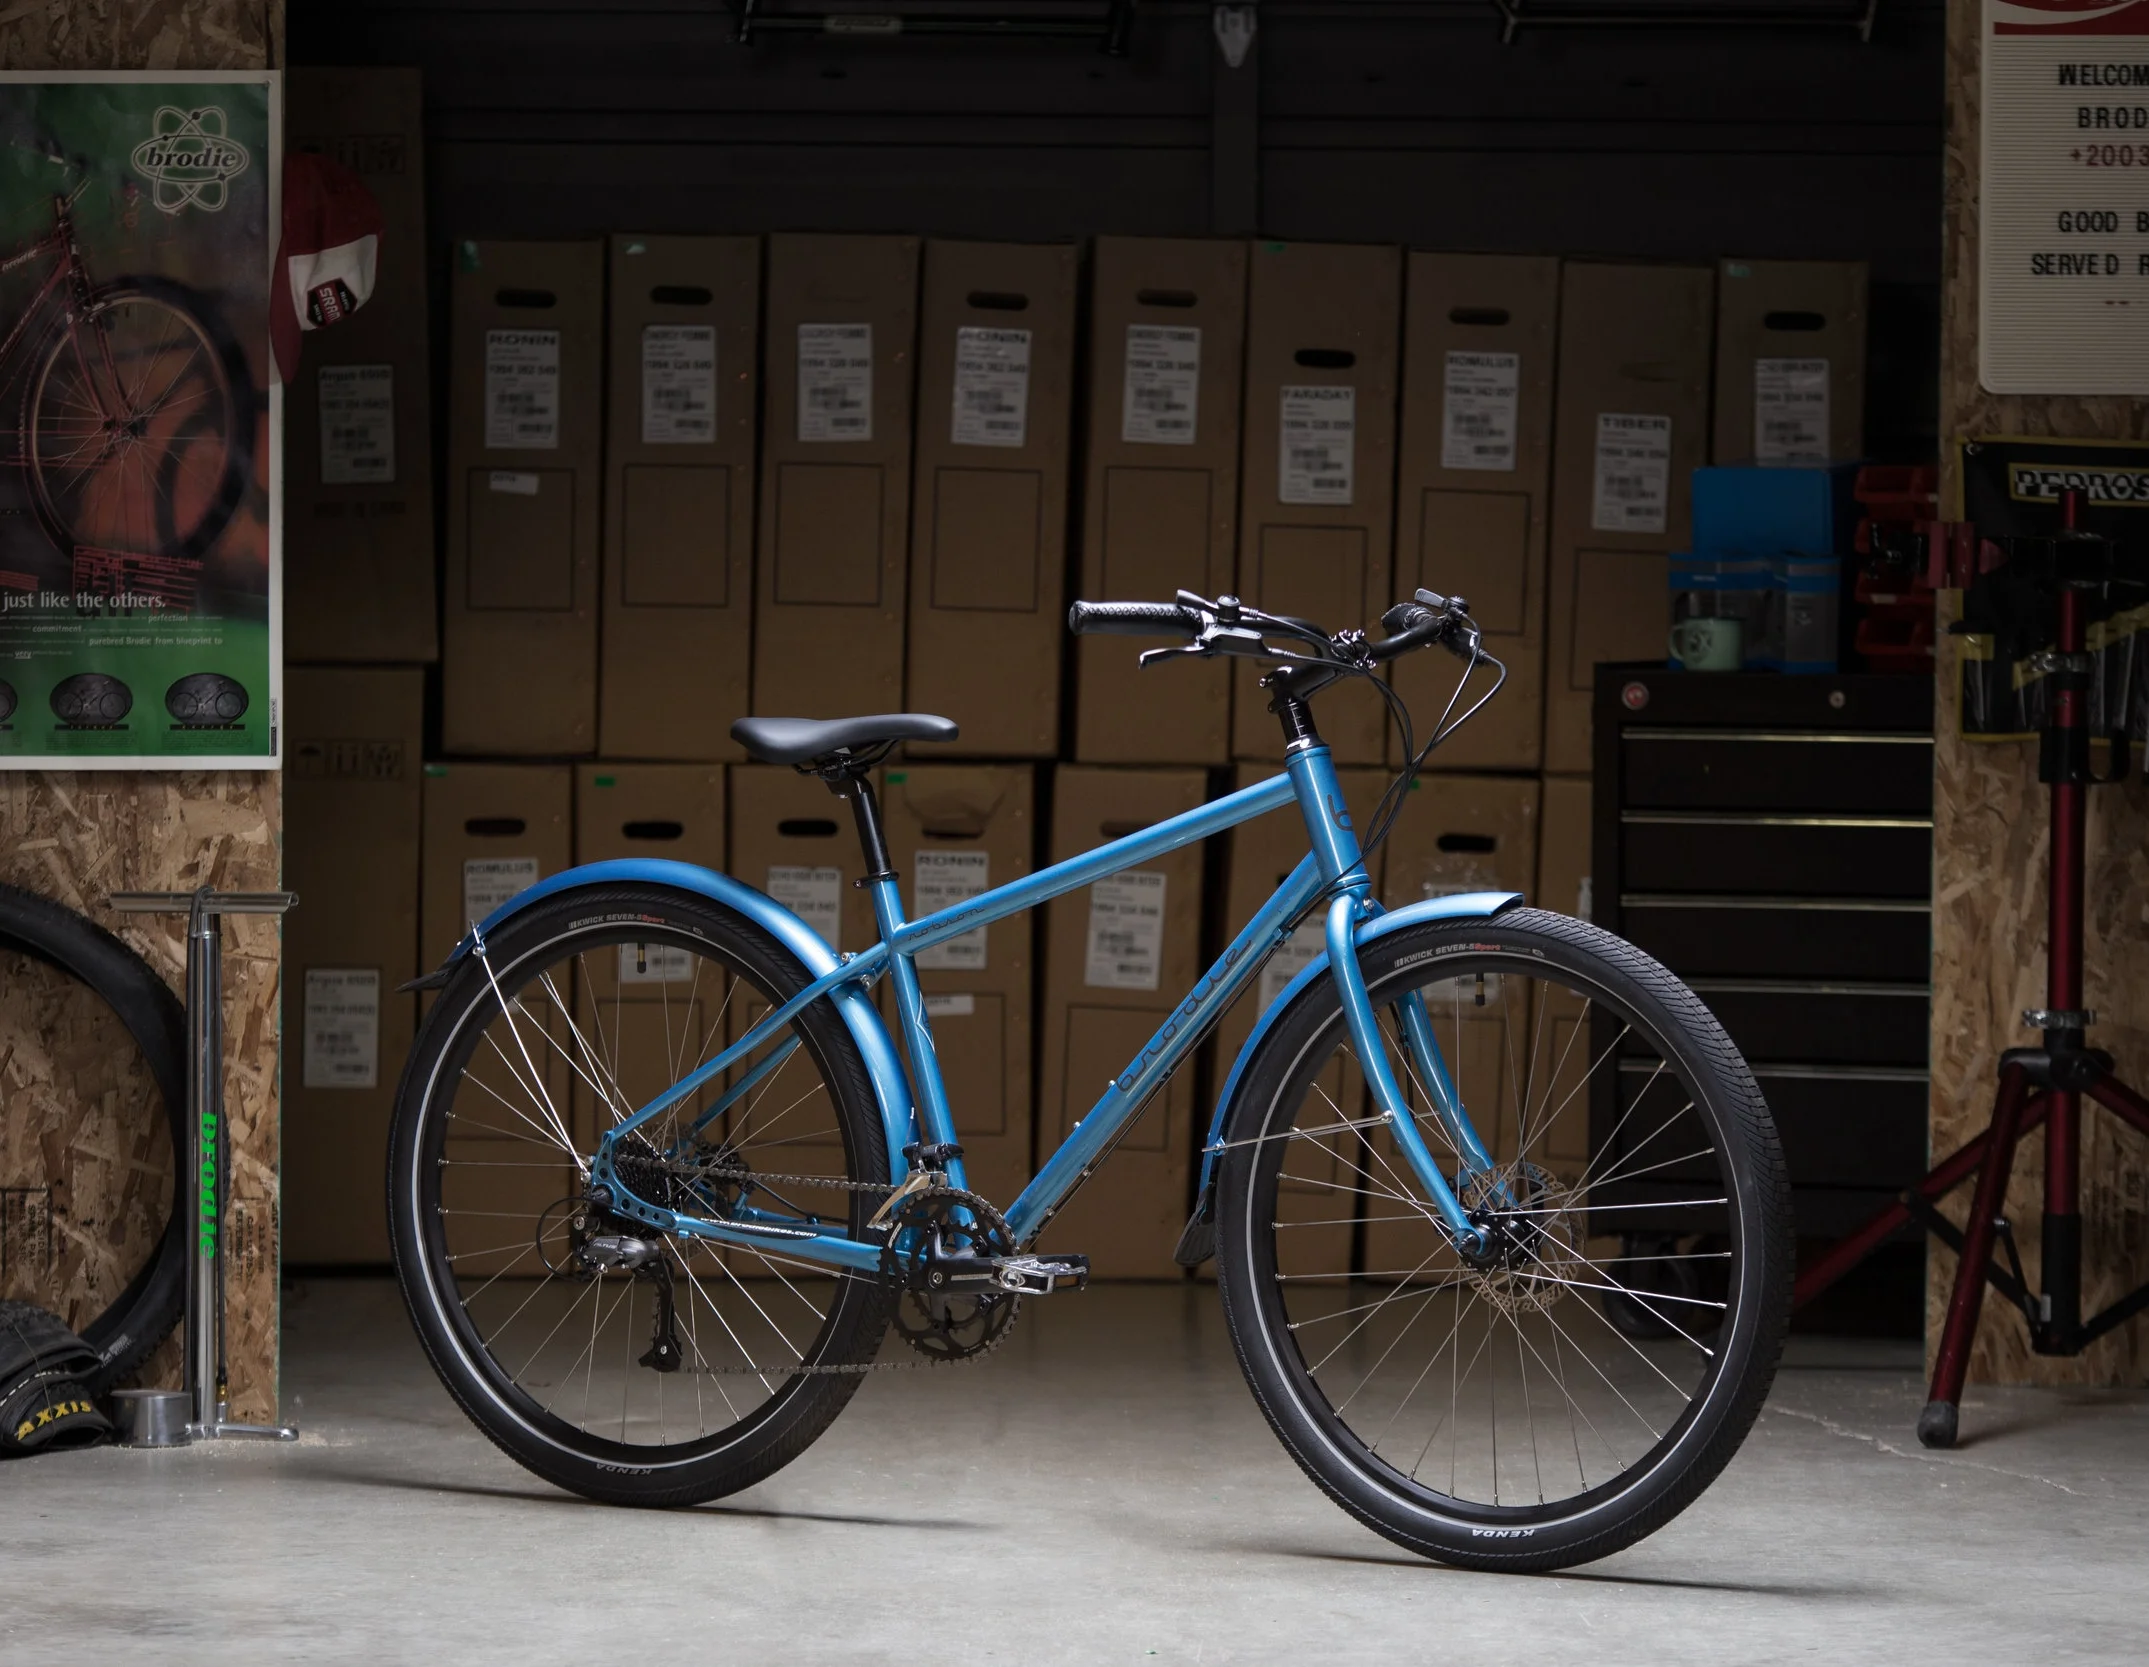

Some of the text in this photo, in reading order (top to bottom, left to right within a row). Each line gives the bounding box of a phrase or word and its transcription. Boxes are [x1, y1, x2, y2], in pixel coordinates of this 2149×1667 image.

[2077, 106, 2148, 128] BROD
[145, 146, 236, 169] brodie
[2058, 211, 2119, 233] GOOD
[2031, 253, 2120, 275] SERVED
[319, 287, 341, 321] SRAM
[2, 592, 167, 612] just like the others.
[148, 613, 188, 623] perfection
[33, 625, 82, 633] commitment
[176, 637, 212, 646] blueprint
[1404, 949, 1433, 964] KWICK
[1116, 940, 1251, 1092] brodie
[200, 1112, 218, 1259] brodie
[595, 1462, 653, 1475] KENDA
[1472, 1528, 1535, 1538] KENDA
